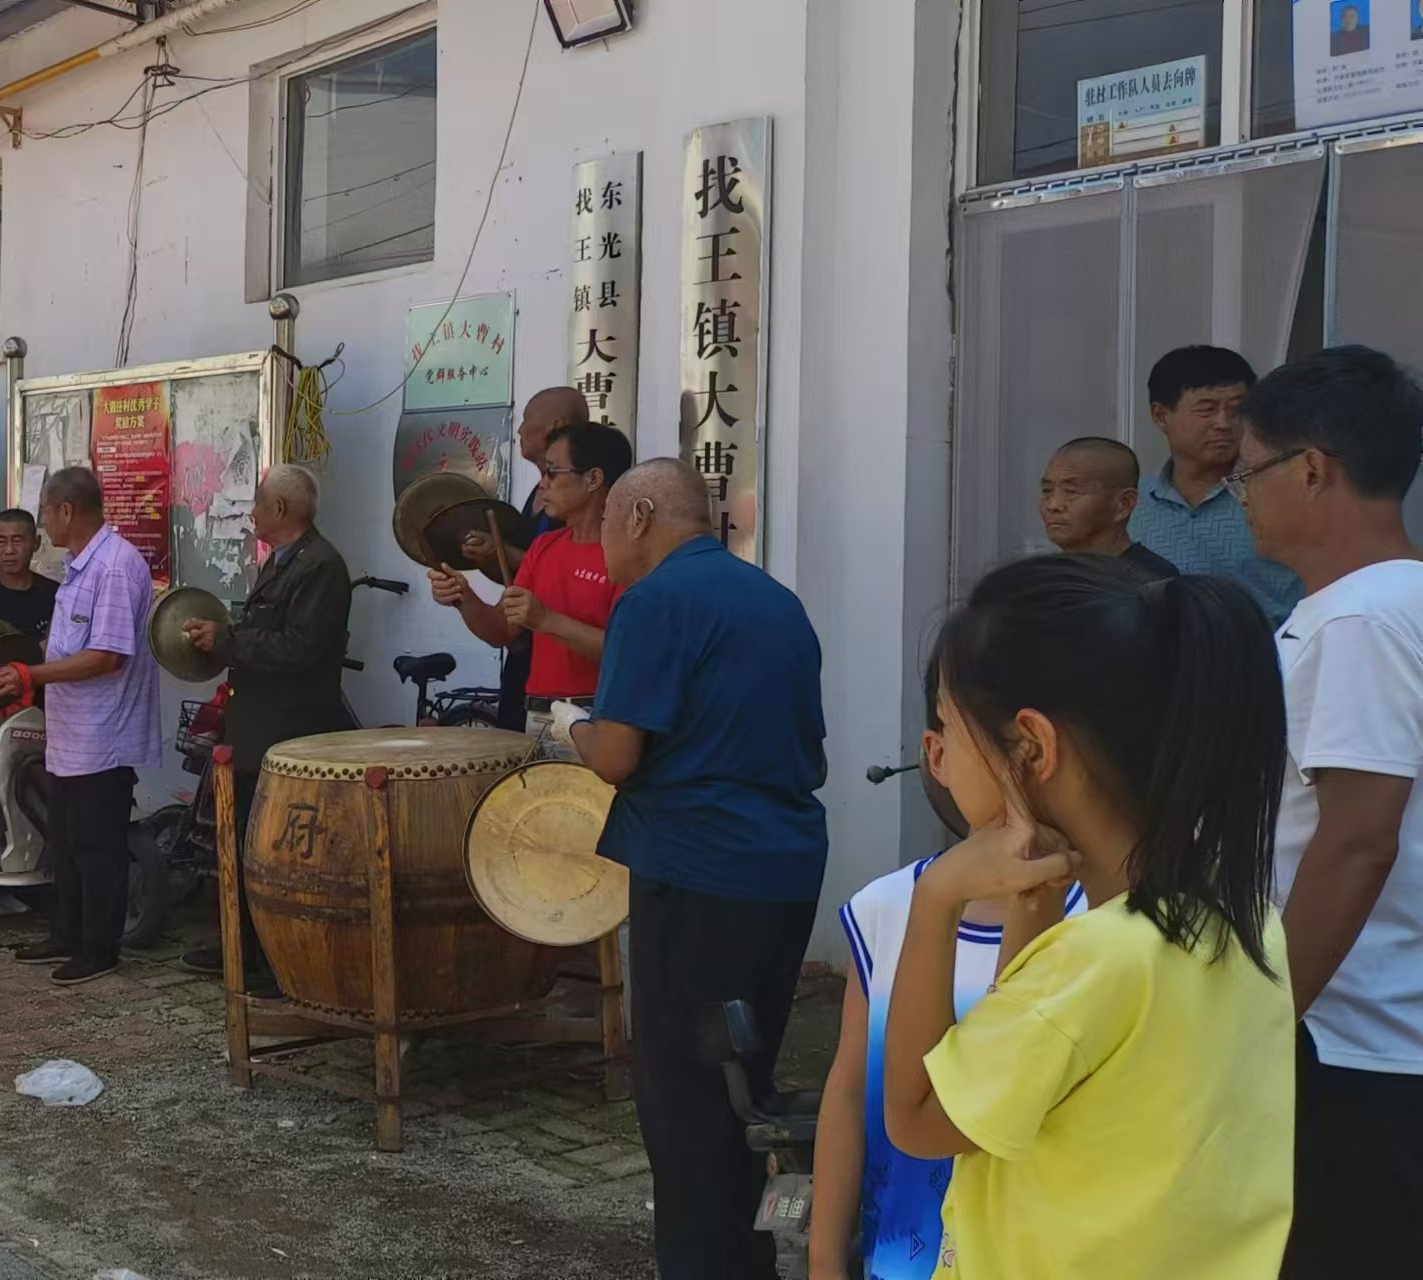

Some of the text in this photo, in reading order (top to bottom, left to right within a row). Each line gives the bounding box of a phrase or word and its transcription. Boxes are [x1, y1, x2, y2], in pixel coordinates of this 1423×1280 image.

[1085, 65, 1196, 107] 驻村工作队人员去向牌
[573, 187, 594, 313] 找王镇
[597, 180, 623, 308] 东光县
[425, 363, 489, 385] 党群服务中心
[402, 421, 489, 473] 代文明实践站
[272, 801, 327, 860] 府
